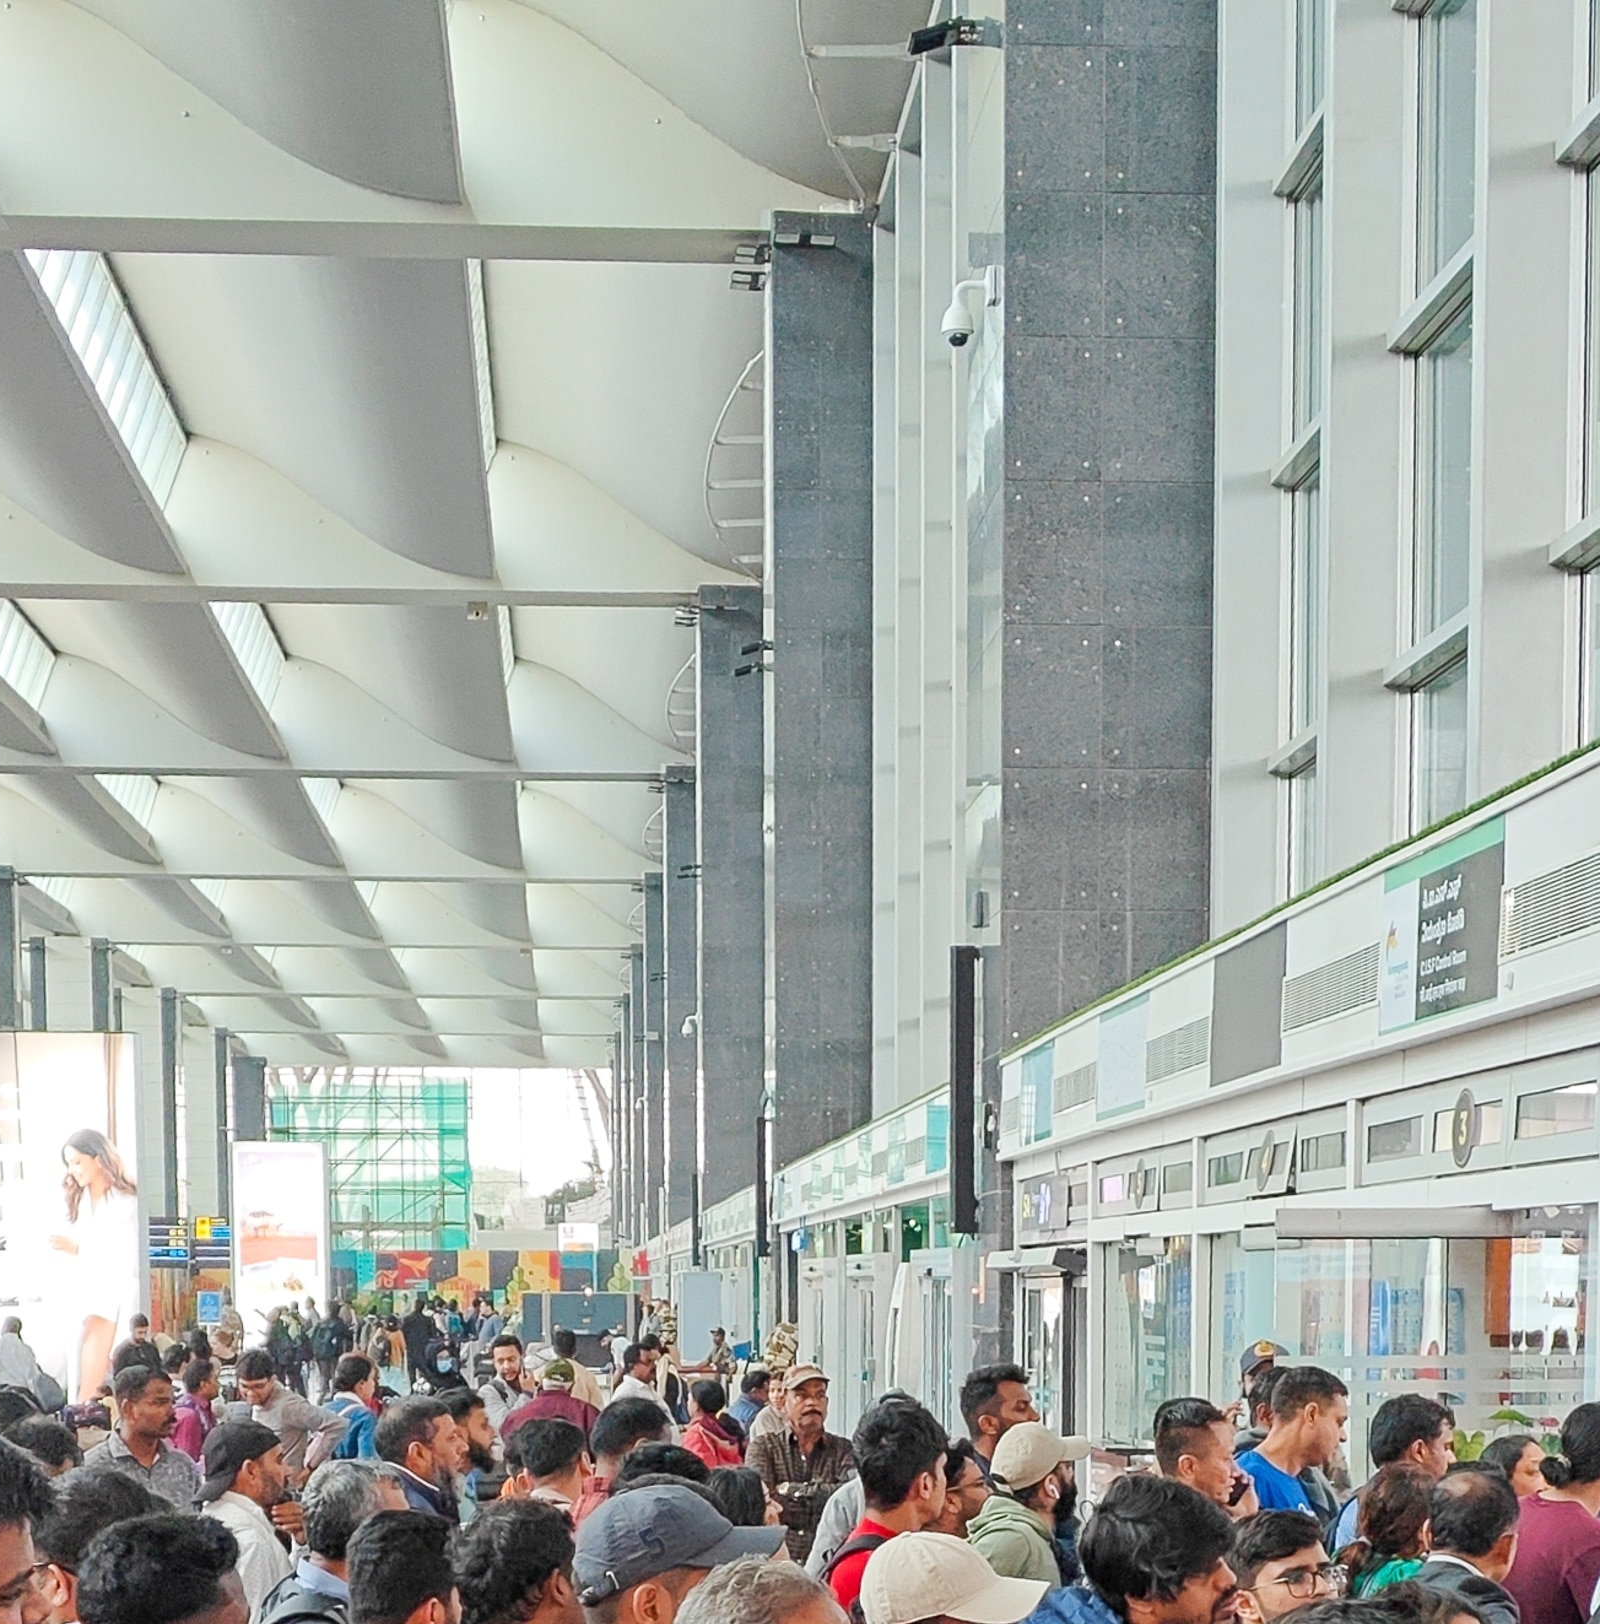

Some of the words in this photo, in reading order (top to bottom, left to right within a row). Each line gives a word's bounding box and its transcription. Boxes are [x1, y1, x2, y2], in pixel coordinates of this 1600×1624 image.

[1435, 950, 1451, 971] Control
[1452, 945, 1466, 965] Room
[1458, 1112, 1469, 1146] 3
